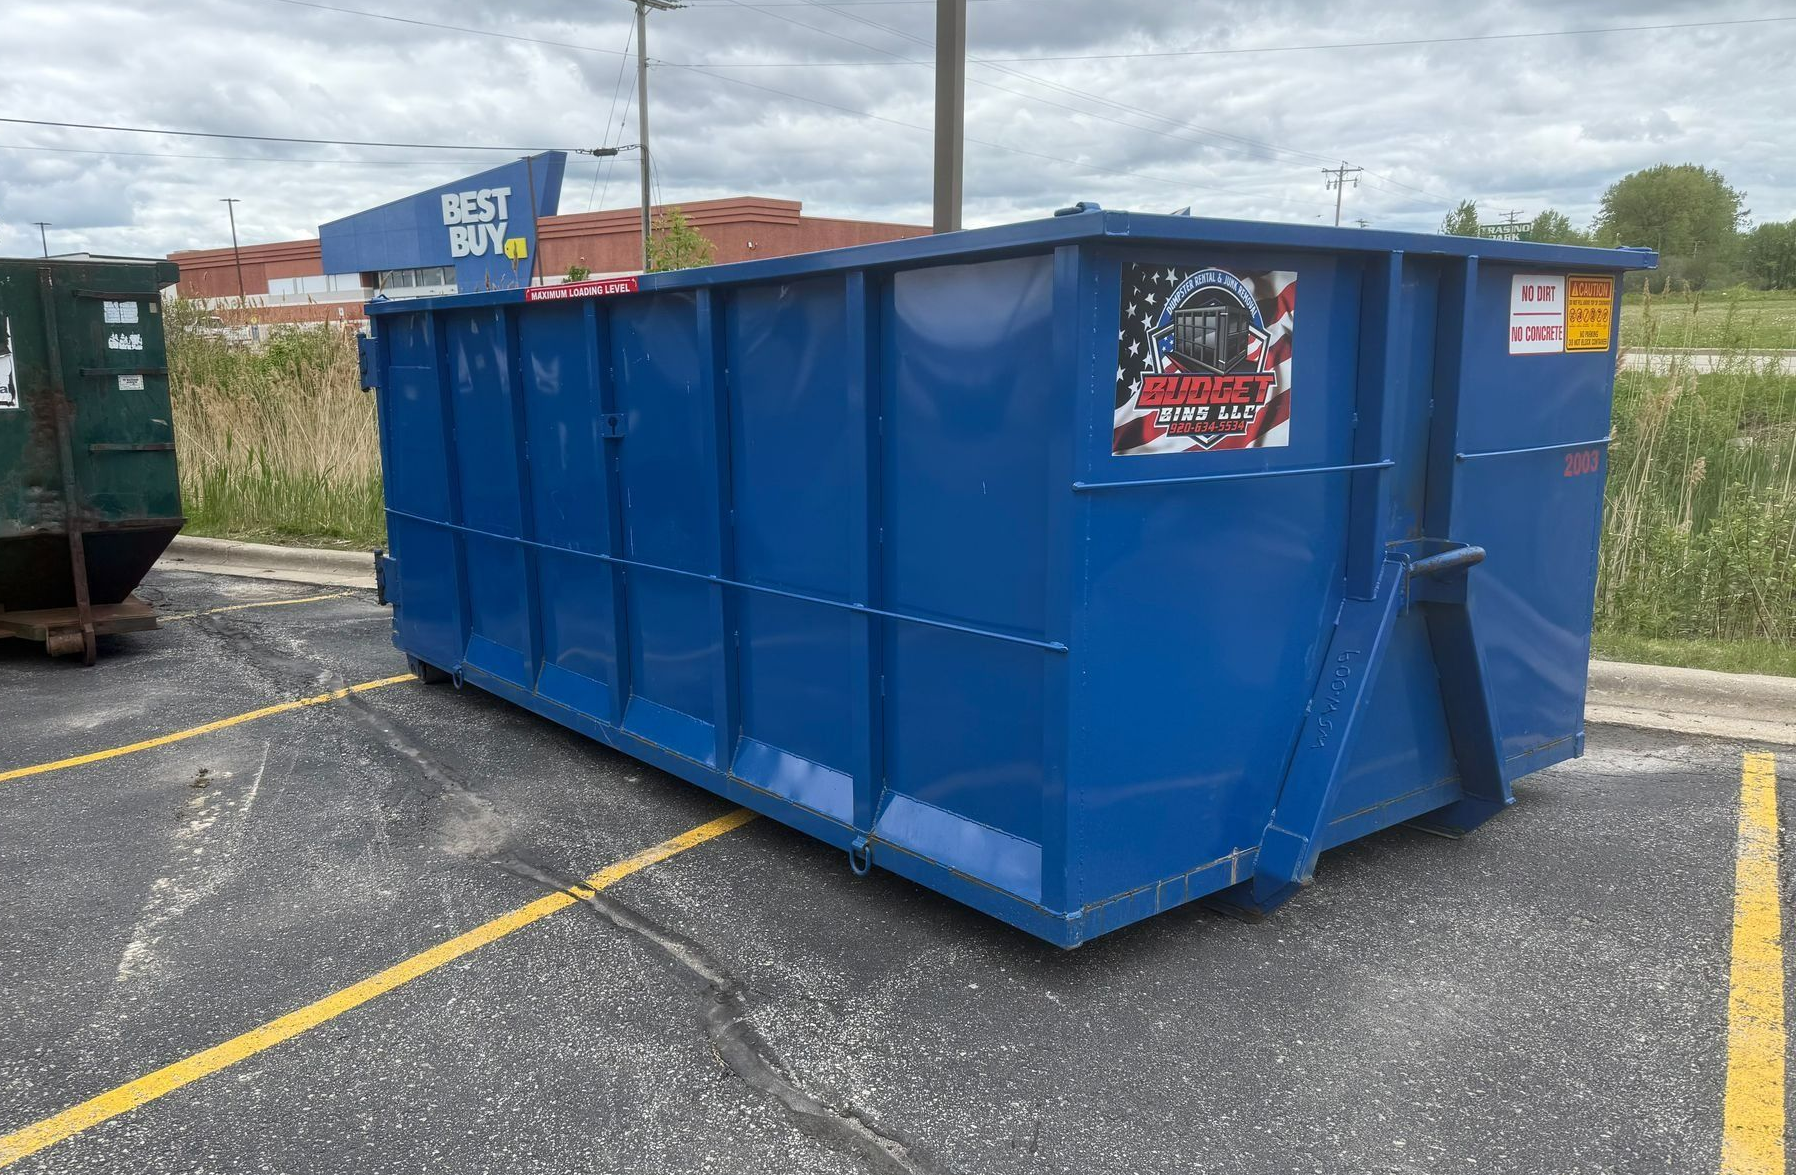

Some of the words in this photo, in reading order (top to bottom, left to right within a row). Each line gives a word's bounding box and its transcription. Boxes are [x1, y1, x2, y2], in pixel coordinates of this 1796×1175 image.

[441, 187, 512, 225] BEST
[449, 222, 508, 257] BUY
[531, 290, 568, 300] MAXIMUM
[569, 285, 603, 297] LOADING
[604, 283, 630, 294] LEVEL
[1166, 279, 1195, 316] DUMPSTER
[1194, 272, 1216, 287] RENTAL
[1217, 273, 1222, 283] &
[1223, 275, 1238, 291] JUNK
[1237, 285, 1258, 318] REMOVAL
[1521, 285, 1534, 302] NO
[1537, 285, 1556, 302] DIRT
[1579, 283, 1609, 296] CAUTION
[1511, 326, 1523, 342] NO
[1525, 325, 1563, 341] CONCRETE
[1138, 376, 1274, 406] BUDGET
[1159, 406, 1210, 422] BINS
[1218, 405, 1256, 420] LLC
[1169, 421, 1245, 434] 920-634-5534
[1564, 450, 1599, 477] 2003
